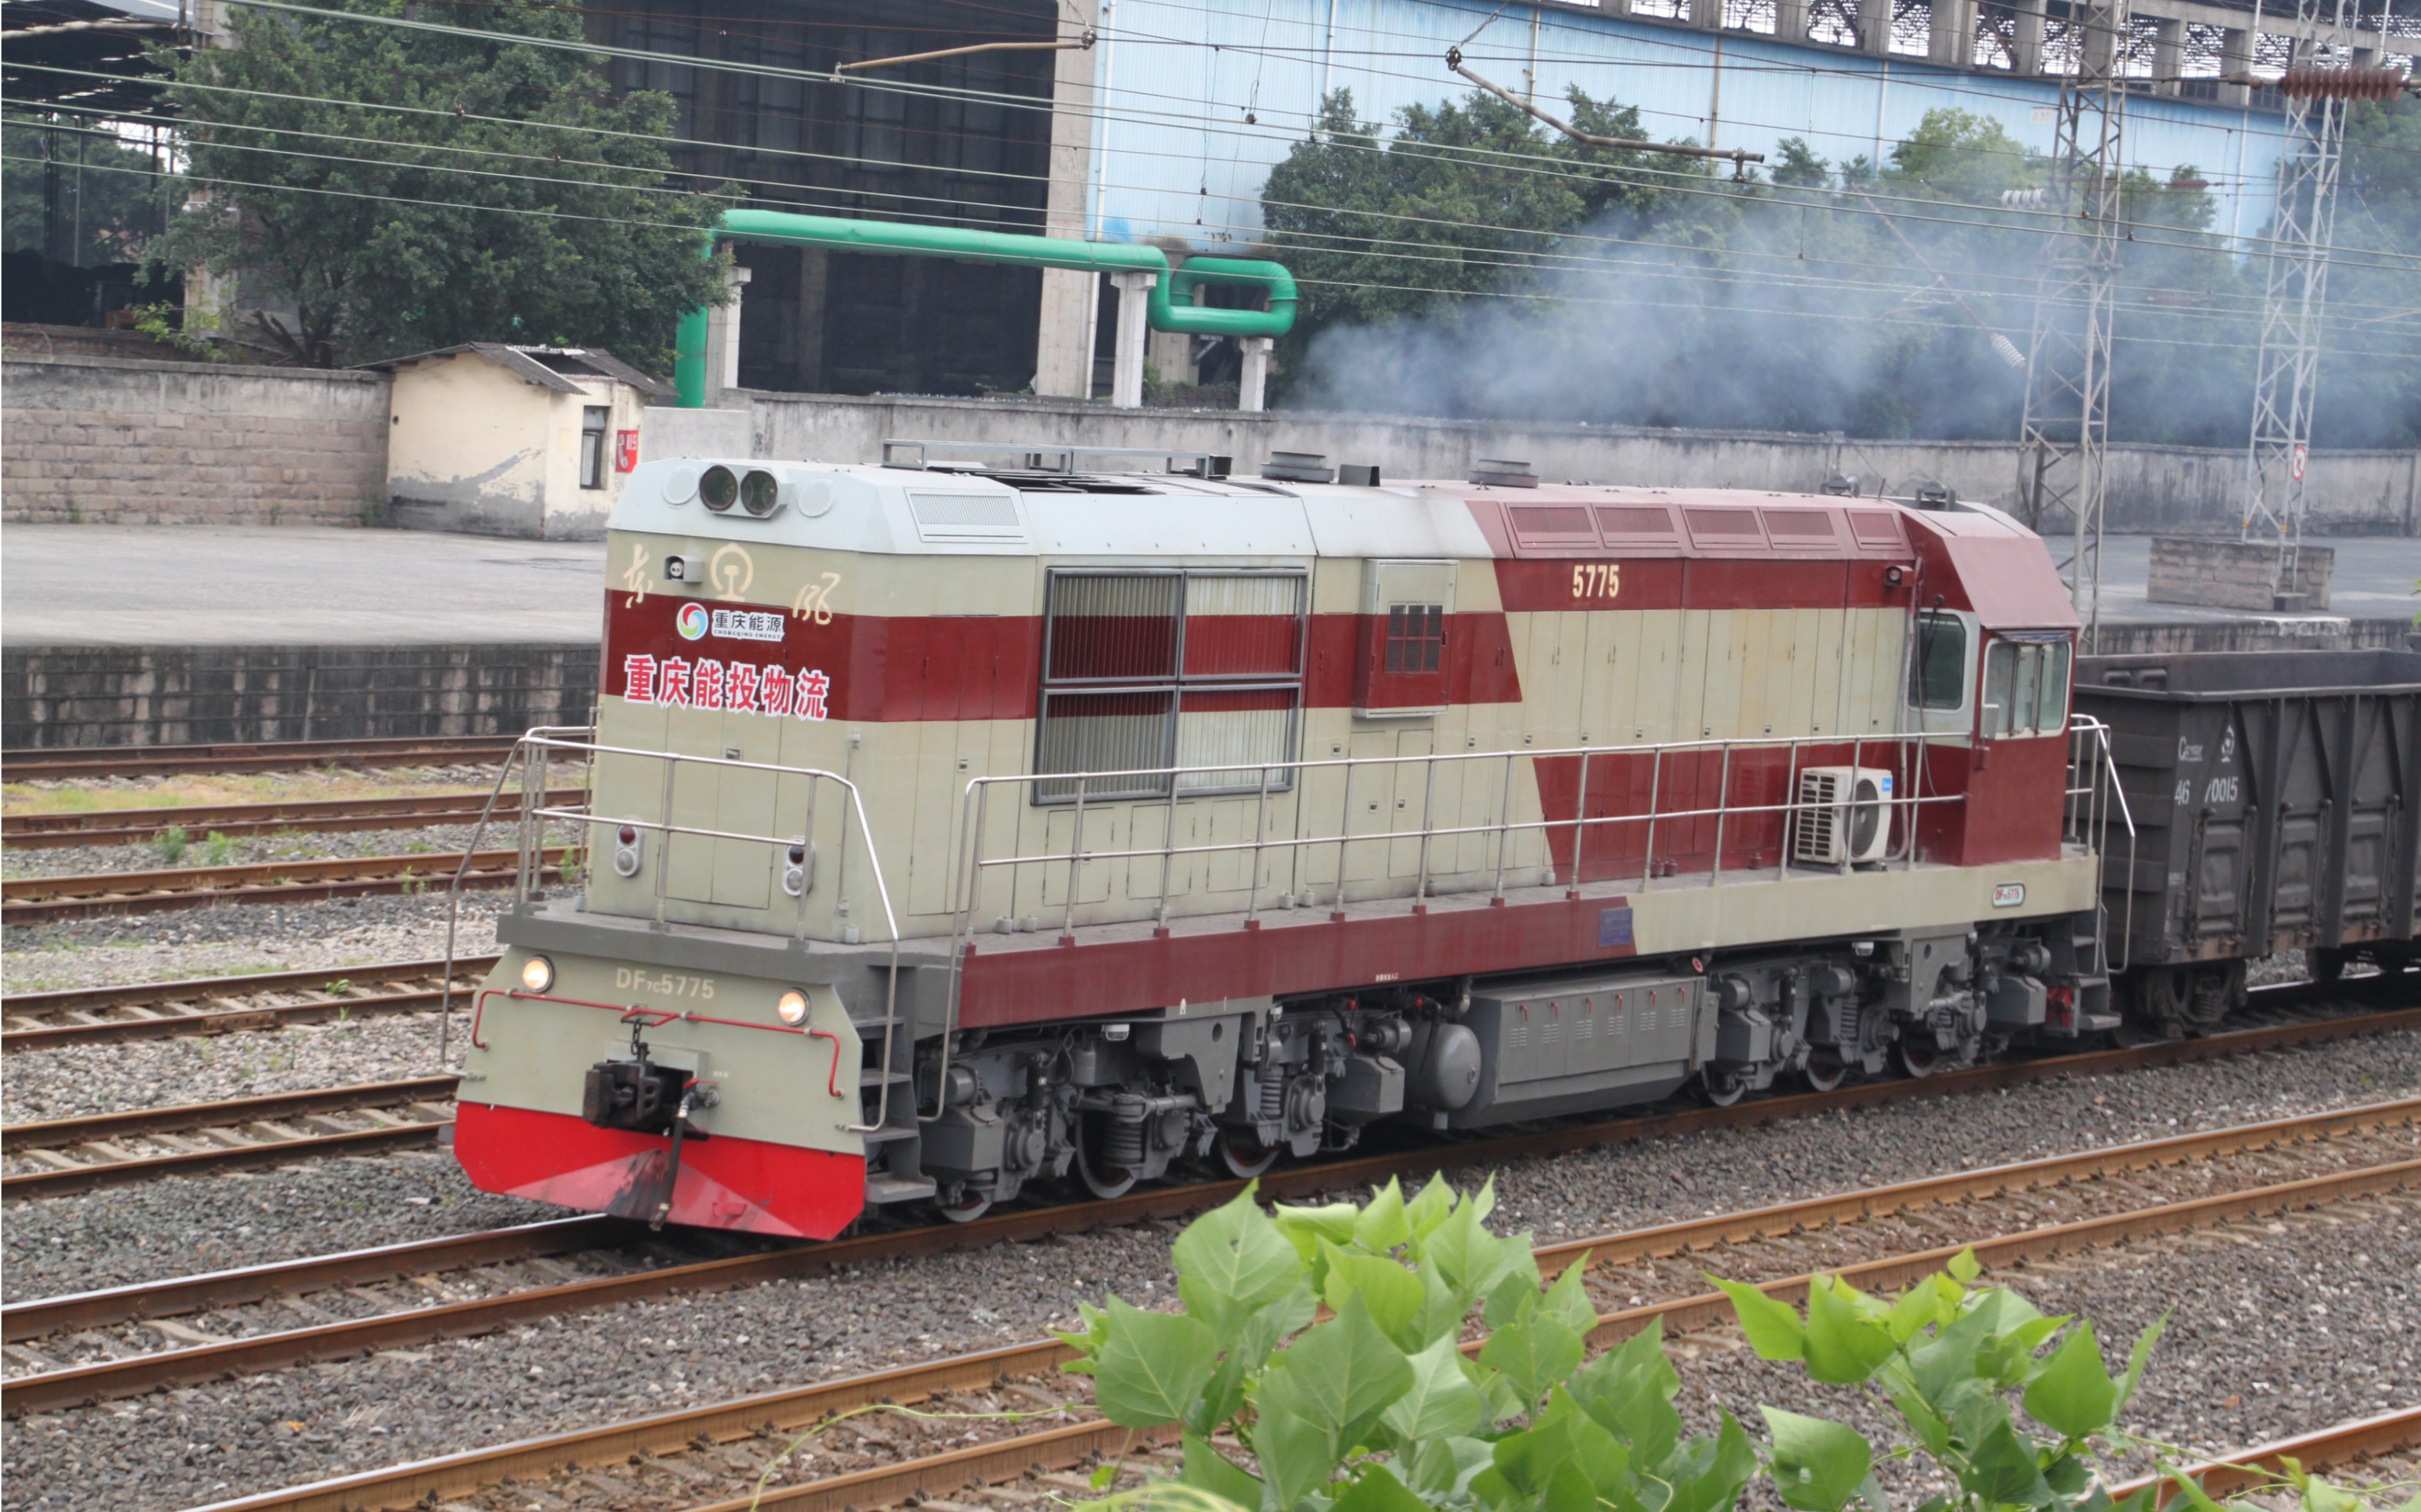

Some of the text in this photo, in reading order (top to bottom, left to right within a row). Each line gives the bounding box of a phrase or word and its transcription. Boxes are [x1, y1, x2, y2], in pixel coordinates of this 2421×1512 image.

[1573, 564, 1619, 597] 5775
[713, 612, 782, 633] 重庆能源
[624, 655, 828, 720] 重庆能投物流
